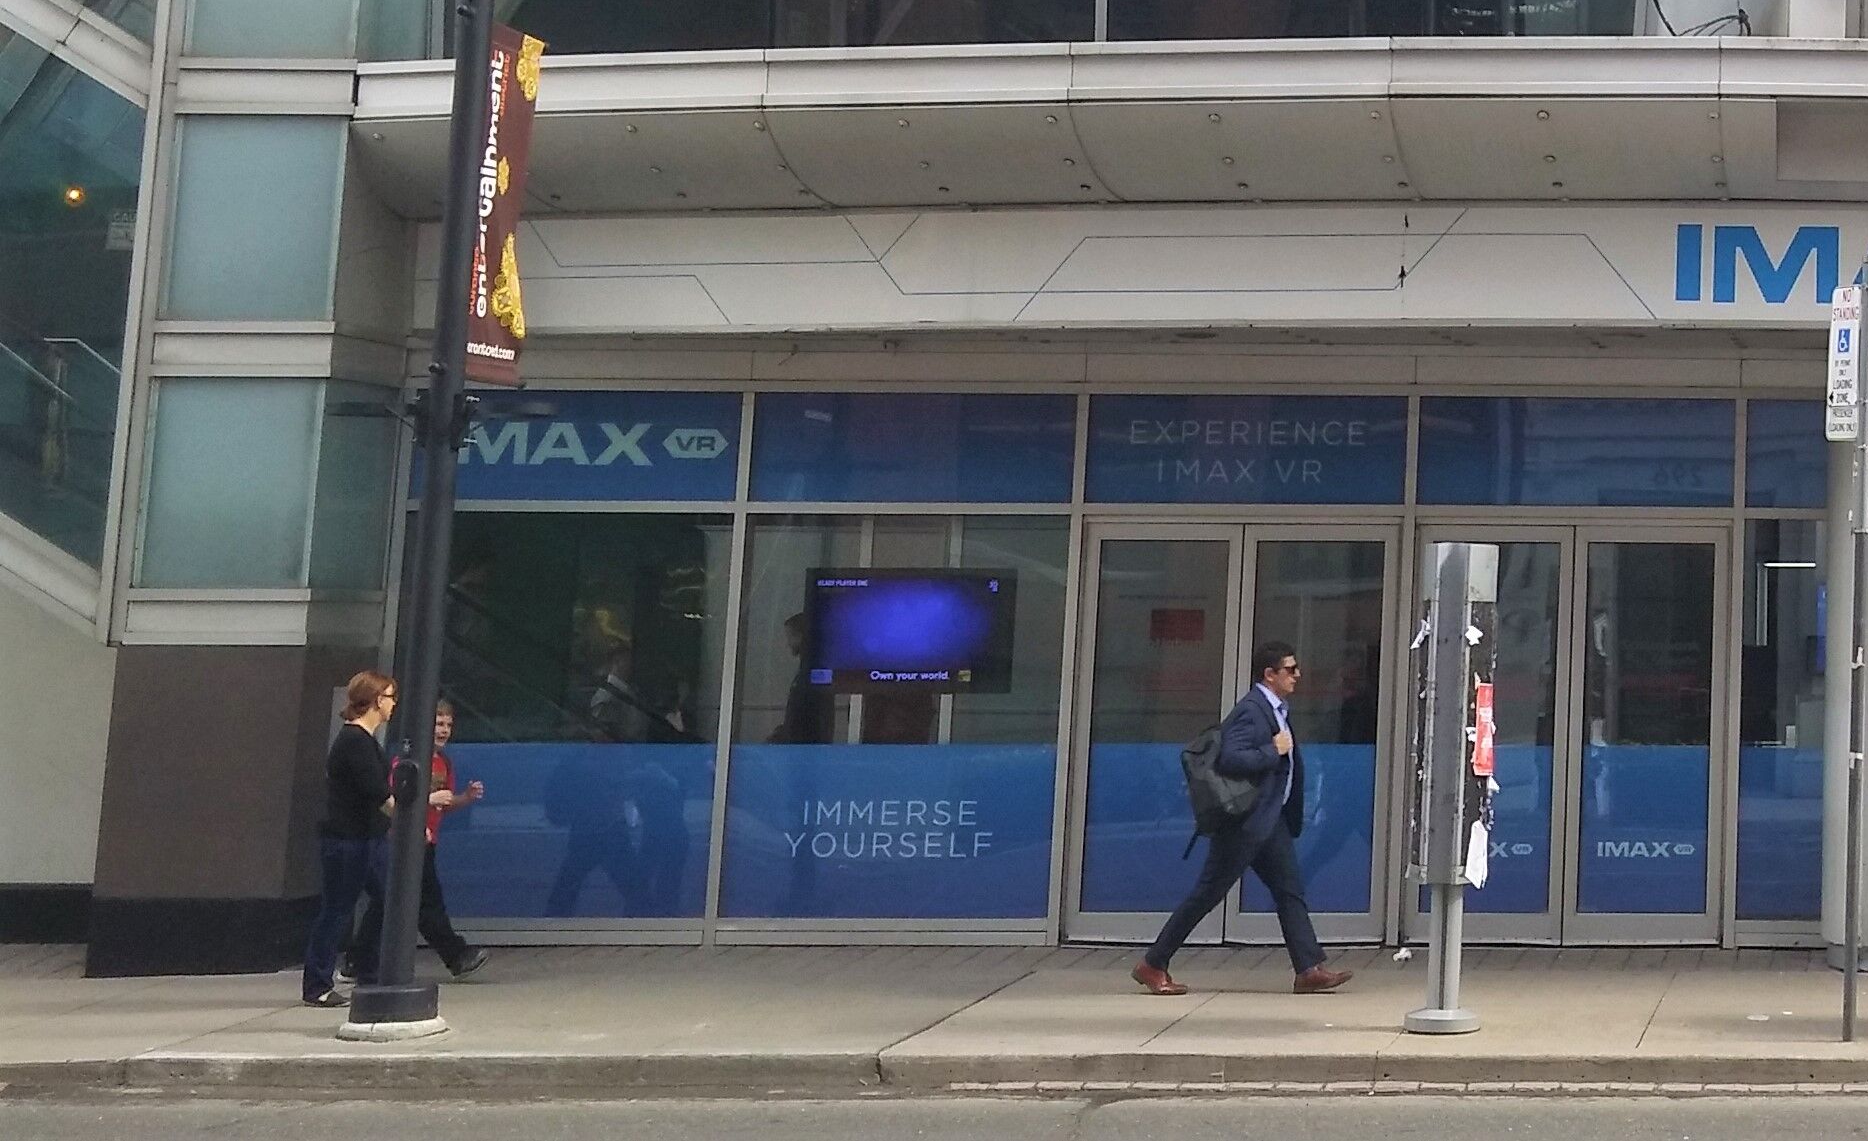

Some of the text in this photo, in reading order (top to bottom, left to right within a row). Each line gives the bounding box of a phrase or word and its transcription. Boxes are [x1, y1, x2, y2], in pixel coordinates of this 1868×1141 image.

[1842, 290, 1852, 303] NO
[457, 421, 716, 467] MAX VR
[1130, 419, 1368, 447] EXPERIENCE
[1157, 459, 1323, 484] IMAX VR
[870, 670, 894, 682] Own
[896, 671, 919, 683] your
[803, 800, 978, 826] IMMERSE
[784, 831, 993, 858] YOURSELF
[1597, 841, 1671, 857] IMAX
